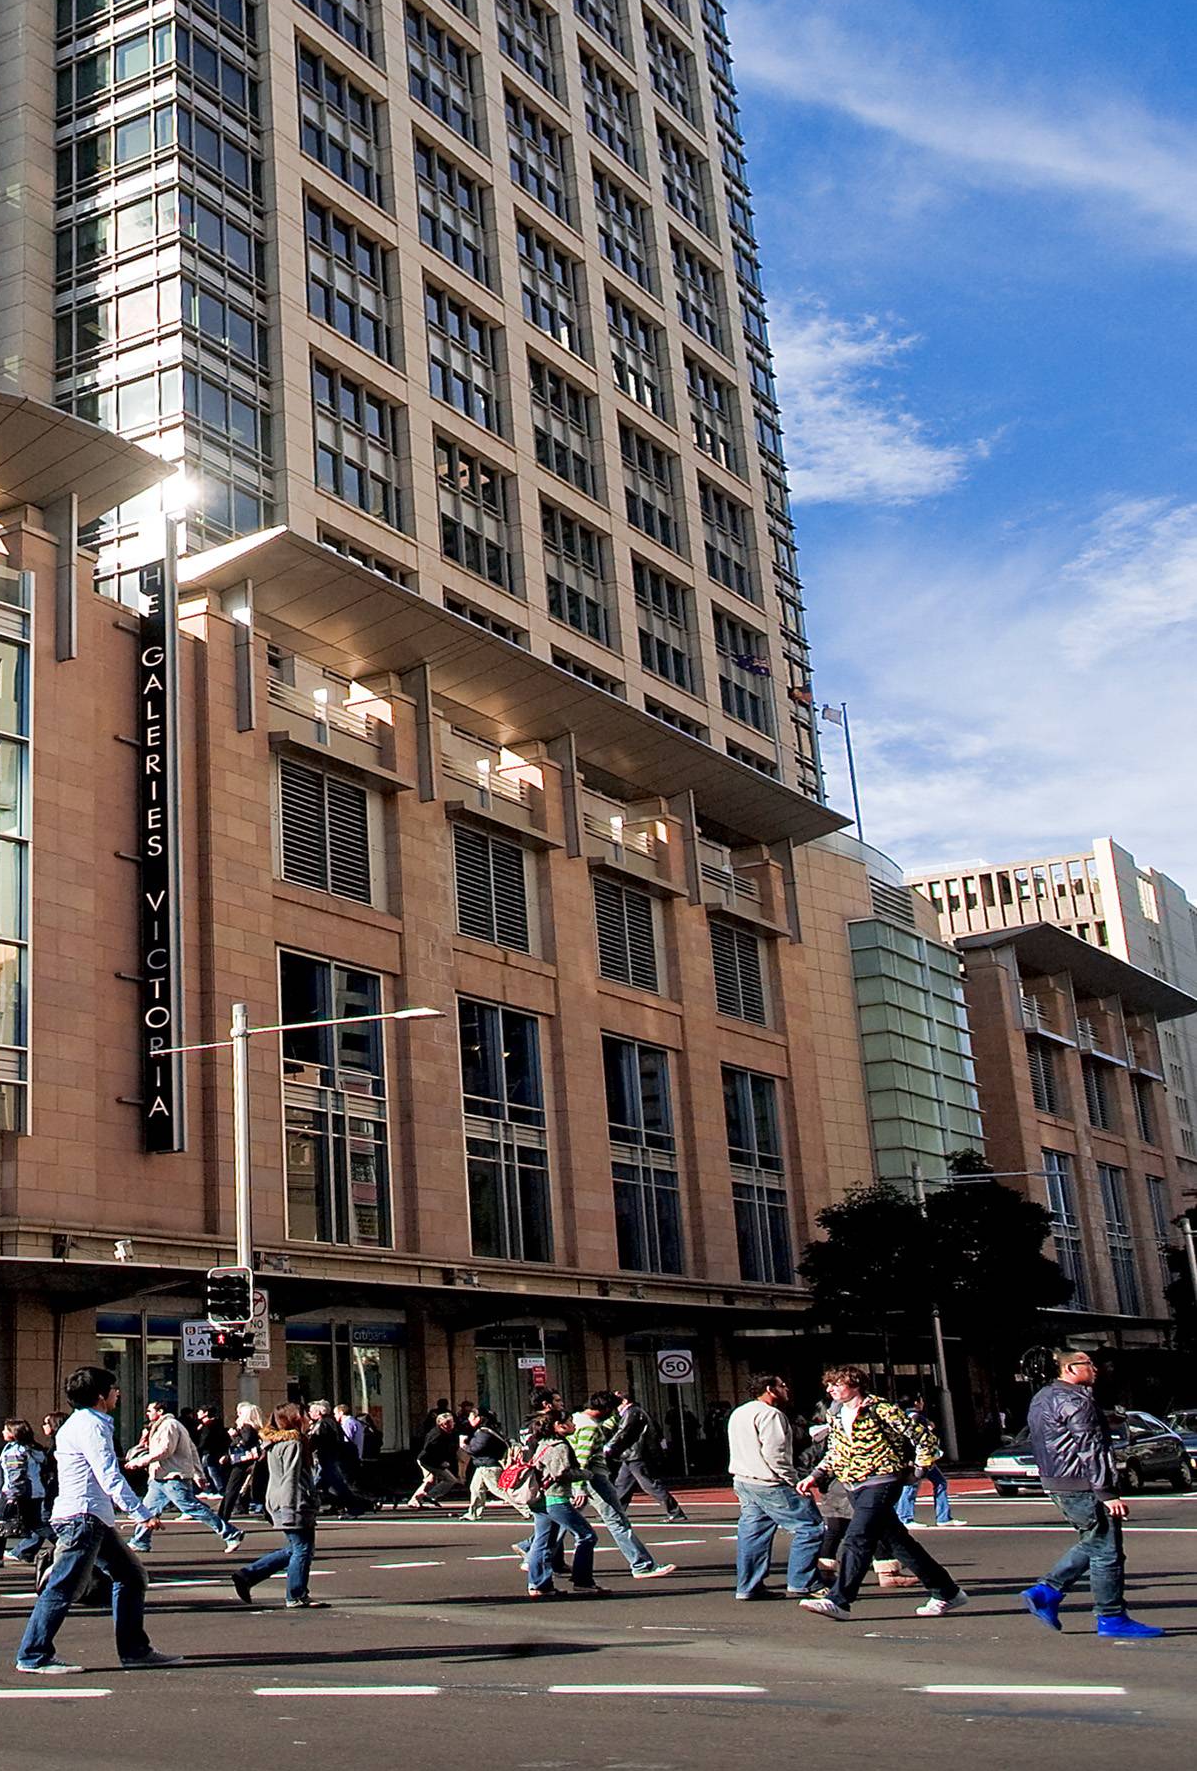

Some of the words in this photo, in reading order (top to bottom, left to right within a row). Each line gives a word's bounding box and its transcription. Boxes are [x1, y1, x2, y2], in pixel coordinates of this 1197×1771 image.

[143, 567, 160, 615] HE
[141, 646, 164, 856] GALERIES
[145, 890, 170, 1117] VICTORIA
[665, 1360, 687, 1373] 50
